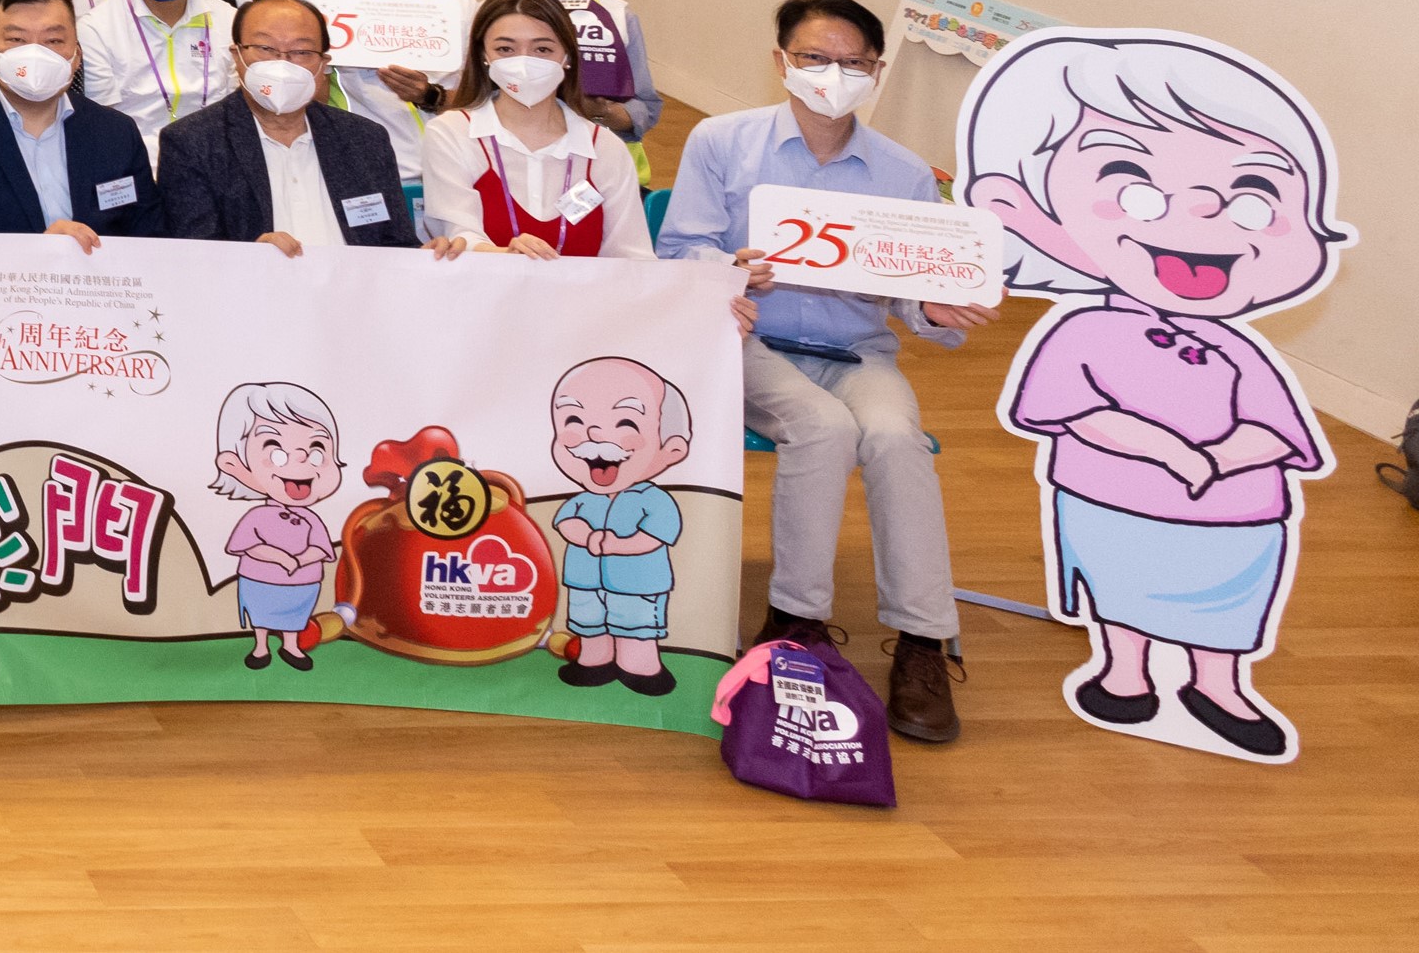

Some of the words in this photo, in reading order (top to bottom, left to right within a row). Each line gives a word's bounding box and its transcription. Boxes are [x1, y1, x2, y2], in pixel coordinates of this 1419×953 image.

[322, 13, 359, 50] 5
[373, 24, 428, 38] 周年紀念
[364, 35, 443, 50] ANNIVERSARY
[763, 218, 855, 268] 25
[856, 245, 868, 255] th
[877, 240, 955, 263] 周年紀念
[863, 252, 977, 280] ANNIVERSARY
[9, 286, 32, 297] Kong
[33, 286, 64, 297] Special
[67, 287, 123, 298] Administrative
[125, 290, 154, 301] Region
[13, 295, 27, 304] the
[29, 296, 63, 307] People's
[65, 297, 102, 308] Republic
[113, 300, 136, 310] China
[19, 322, 130, 352] 周年紀念
[0, 345, 159, 380] ANNIVERSARY
[417, 469, 476, 531] 福
[425, 555, 516, 586] hkva
[424, 592, 476, 601] VOLUNTEERS
[424, 601, 528, 615] 香港志願者協會
